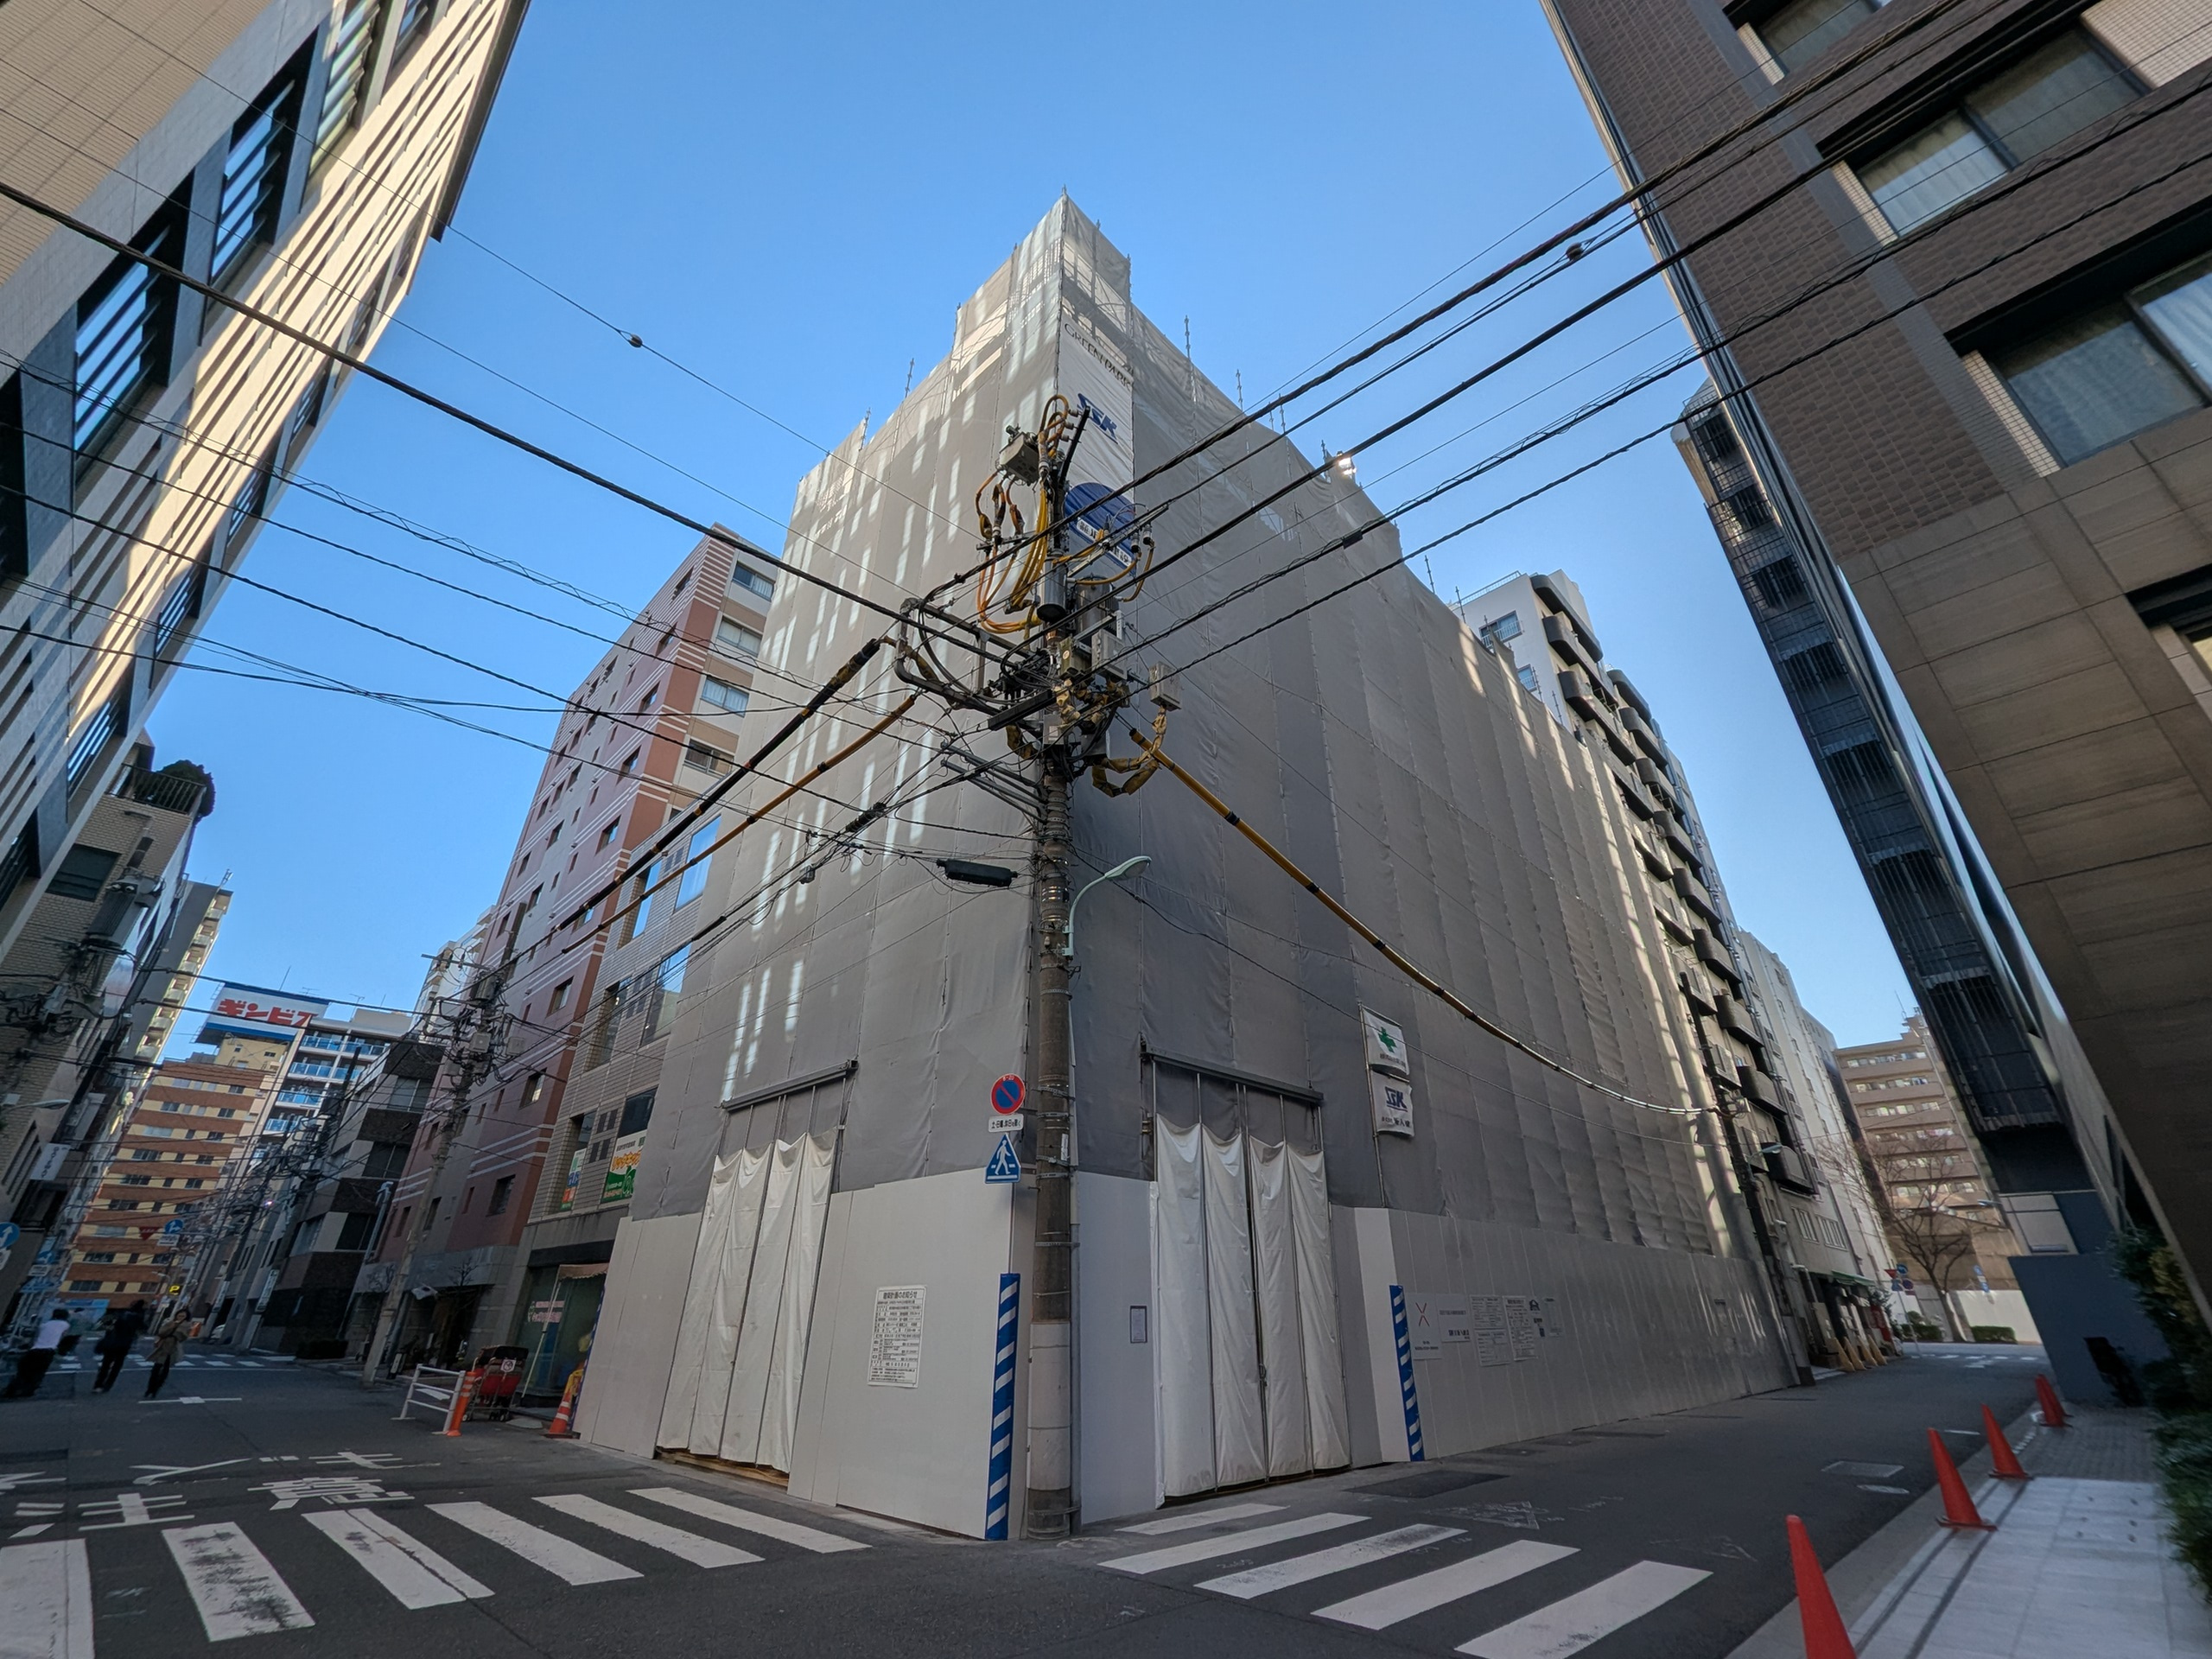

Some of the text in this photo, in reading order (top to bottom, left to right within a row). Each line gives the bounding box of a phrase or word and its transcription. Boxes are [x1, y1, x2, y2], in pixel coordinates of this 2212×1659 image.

[1065, 323, 1131, 392] GREEN PARK
[9, 1476, 416, 1538] 注意
